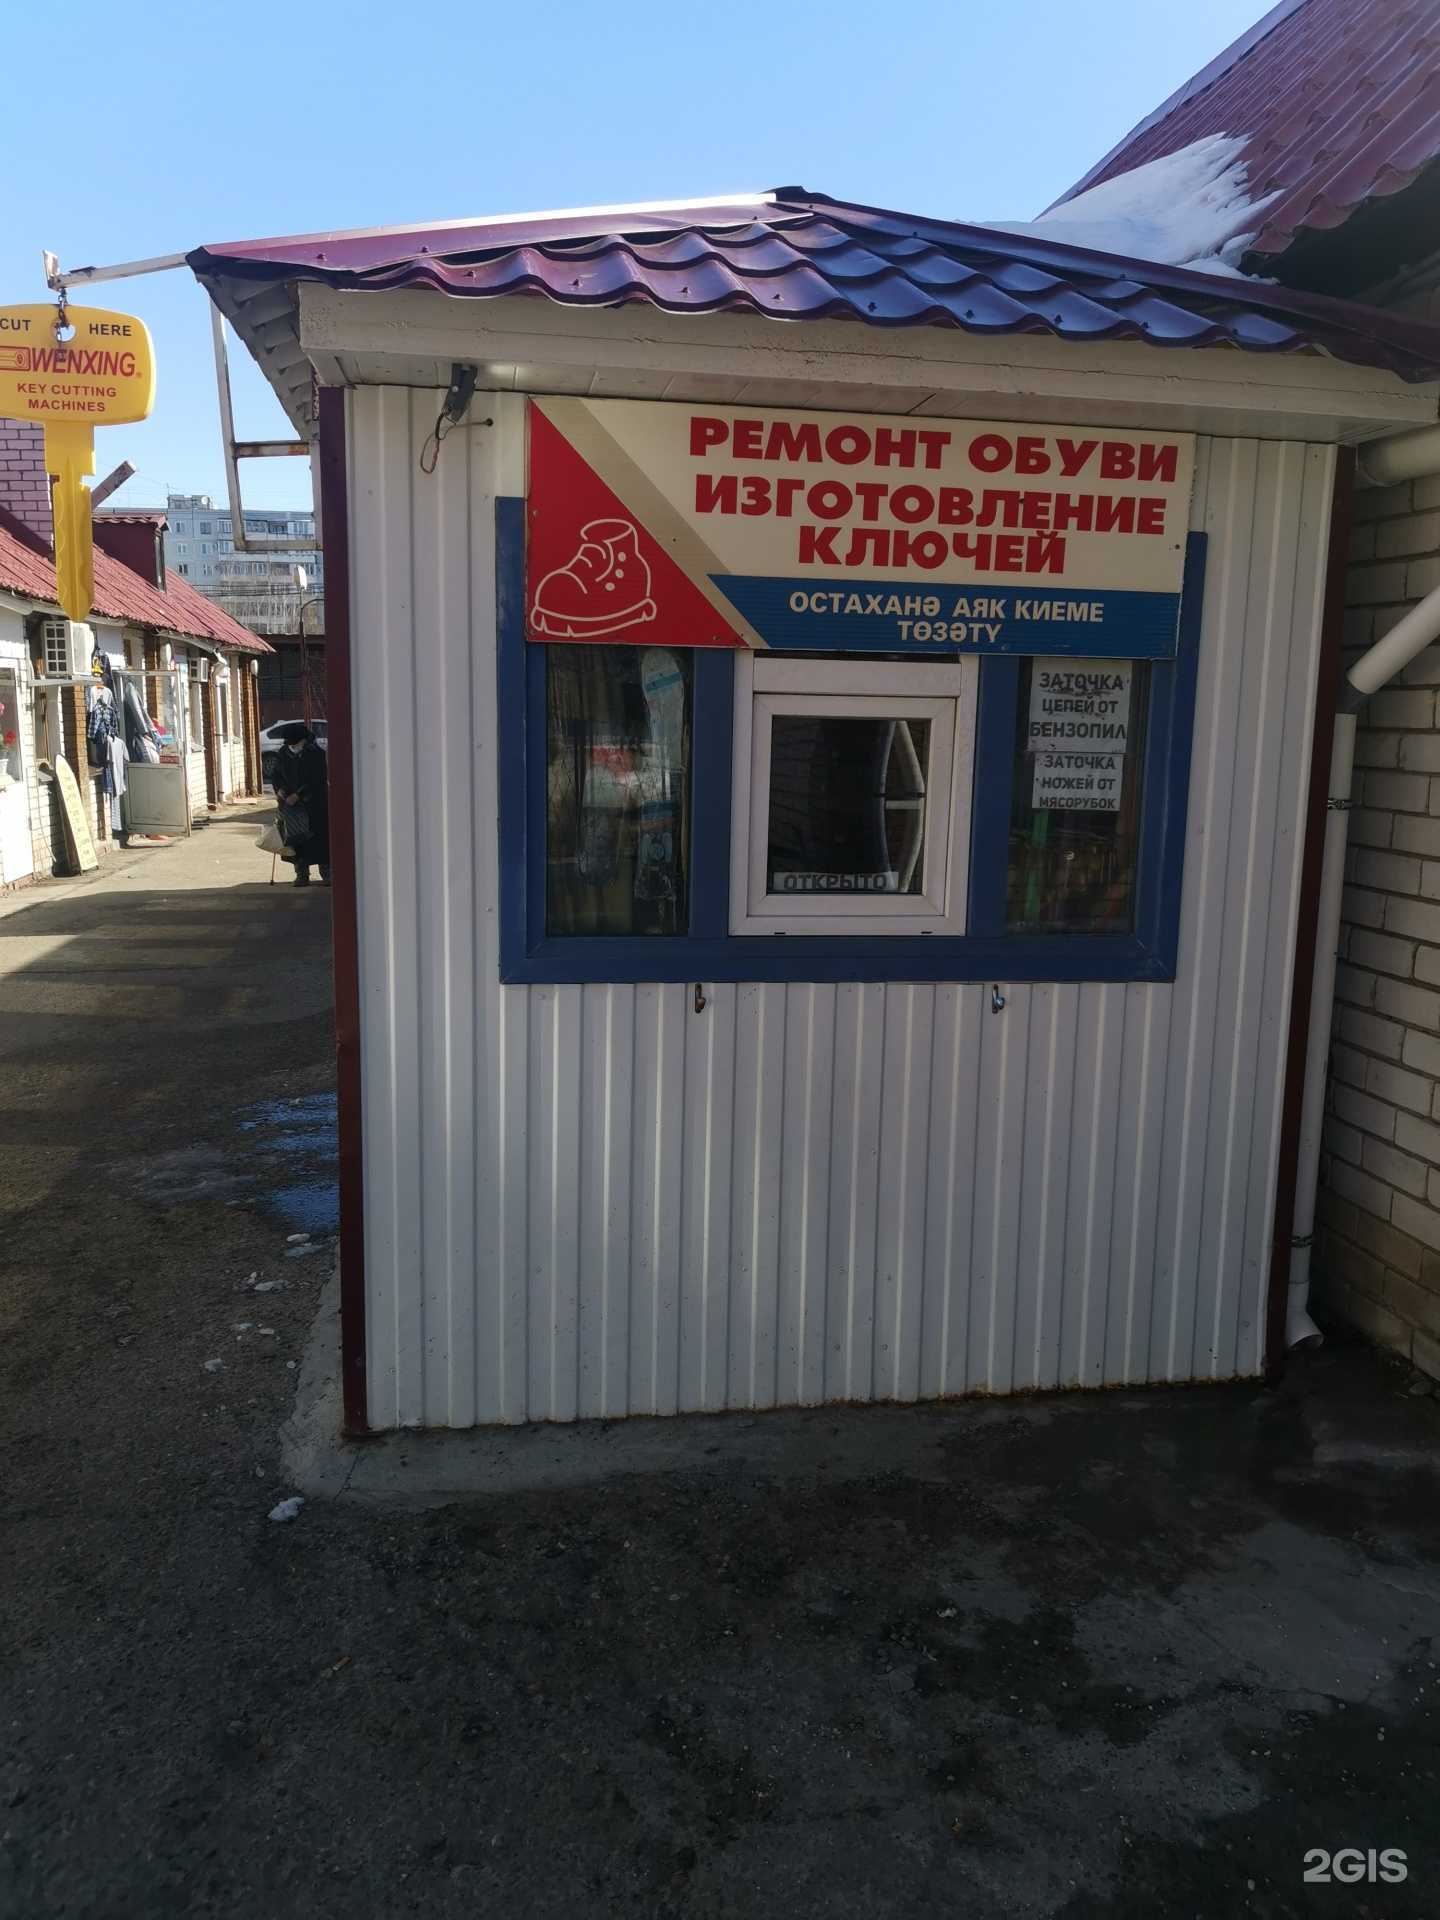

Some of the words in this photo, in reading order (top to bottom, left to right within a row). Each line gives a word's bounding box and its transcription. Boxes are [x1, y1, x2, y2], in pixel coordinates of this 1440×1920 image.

[0, 318, 31, 331] CUT
[89, 323, 132, 336] HERE
[31, 347, 136, 377] WENXING
[17, 383, 47, 394] KEY
[51, 384, 117, 398] CUTTING
[28, 399, 106, 412] MACHINES
[689, 416, 951, 470] РЕМОНТ
[968, 433, 1178, 482] ОБУВИ
[695, 473, 1167, 535] ИЗГОТОВЛЕНИЕ
[798, 525, 1067, 574] КЛЮЧЕЙ
[789, 592, 941, 616] ОСТАХАНӘ
[954, 597, 1006, 619] АЯК
[1015, 600, 1105, 623] КИЕМЕ
[1039, 672, 1124, 690] ЗАТОЧКА
[1041, 697, 1094, 715] ЦЕПЕЙ
[1098, 700, 1119, 713] ОТ
[1029, 721, 1127, 739] БЕНЗОПИЛ
[1044, 755, 1116, 769] ЗАТОЧКА
[1042, 775, 1094, 790] НОЖЕЙ
[1097, 778, 1116, 790] ОТ
[1039, 796, 1116, 809] МЯСОРУБОК
[784, 874, 887, 889] ОТКРЫТО
